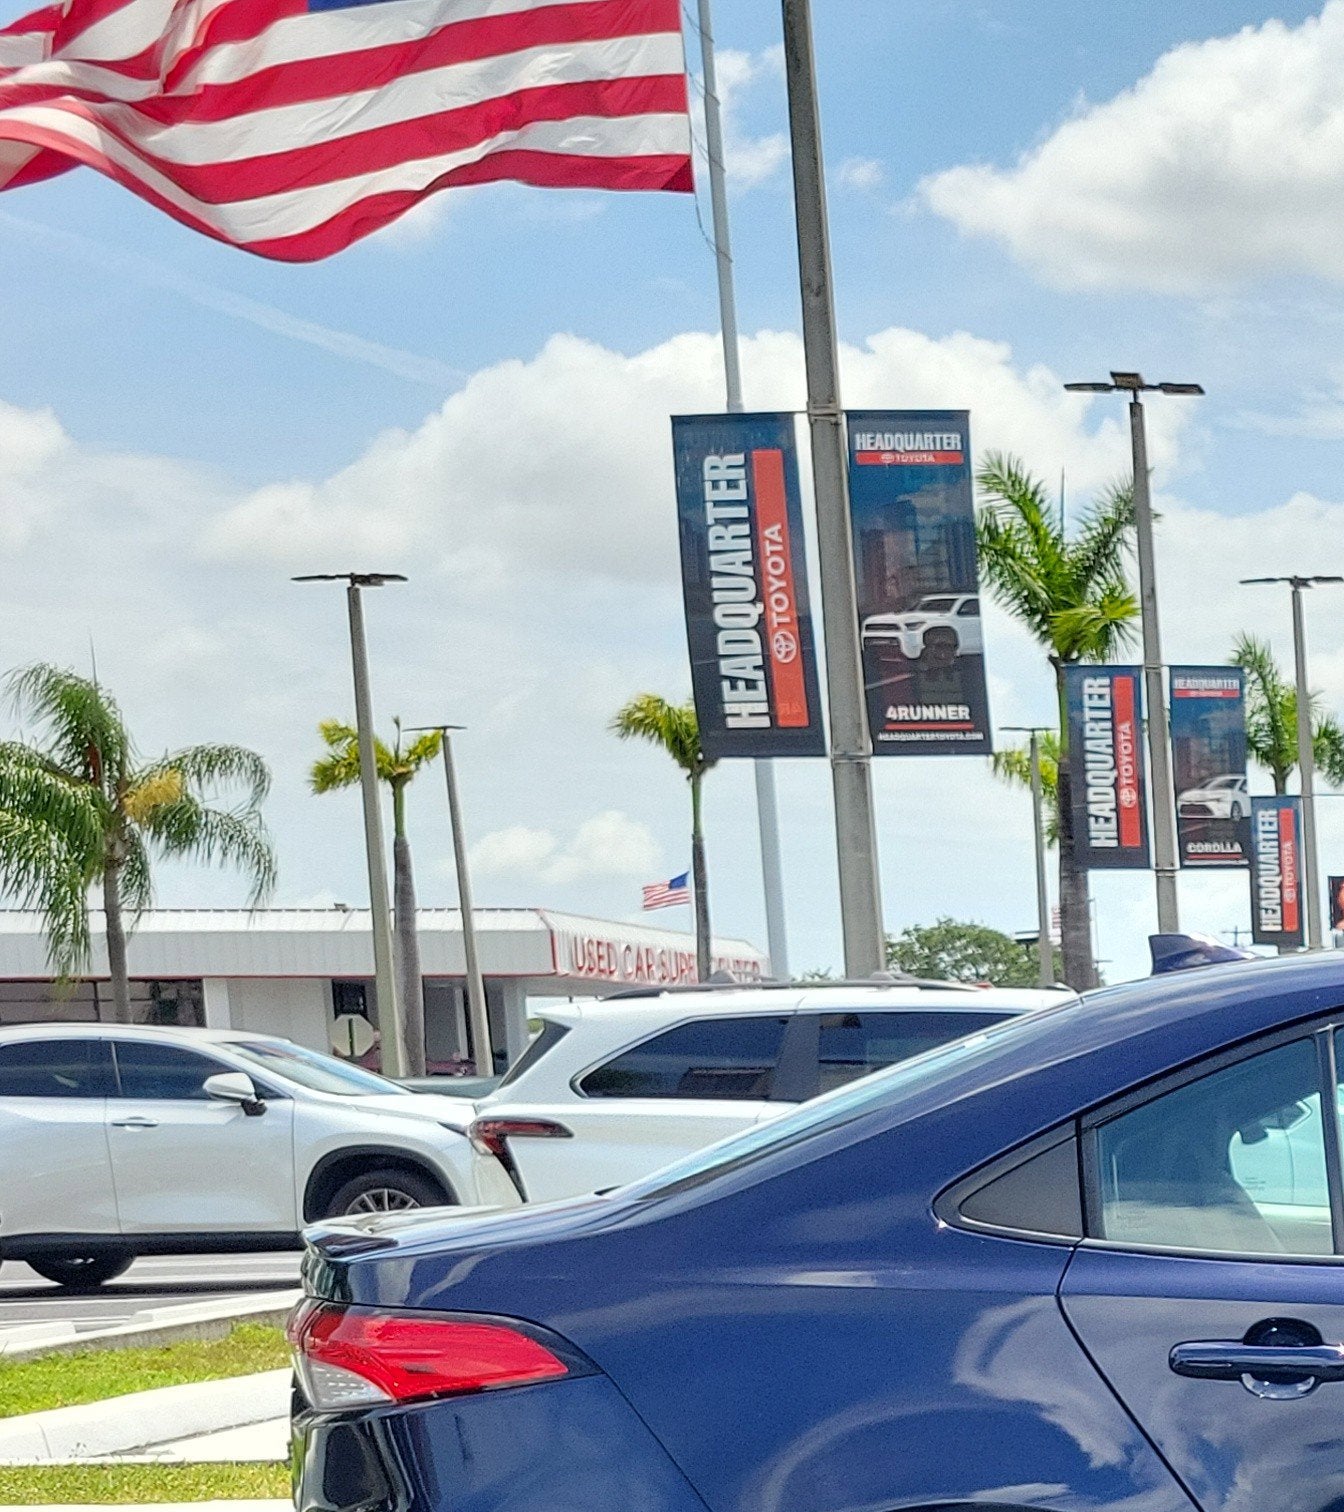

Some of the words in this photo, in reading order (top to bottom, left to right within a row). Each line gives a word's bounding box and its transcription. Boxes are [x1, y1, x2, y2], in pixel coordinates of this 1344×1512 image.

[855, 432, 962, 453] HEADQUARTER
[896, 453, 936, 463] TOYOTA
[703, 452, 772, 729] HEADQUARTER
[763, 522, 791, 627] TOYOTA
[885, 704, 971, 720] 4RUNNER
[1083, 676, 1119, 847] HEADQUARTER
[1117, 721, 1134, 786] TOYOTA
[1186, 841, 1243, 854] COROLLA
[1257, 810, 1283, 932] HEADQUARTER
[573, 936, 618, 975] USED
[623, 943, 656, 981] CAR
[659, 948, 699, 984] SUPE
